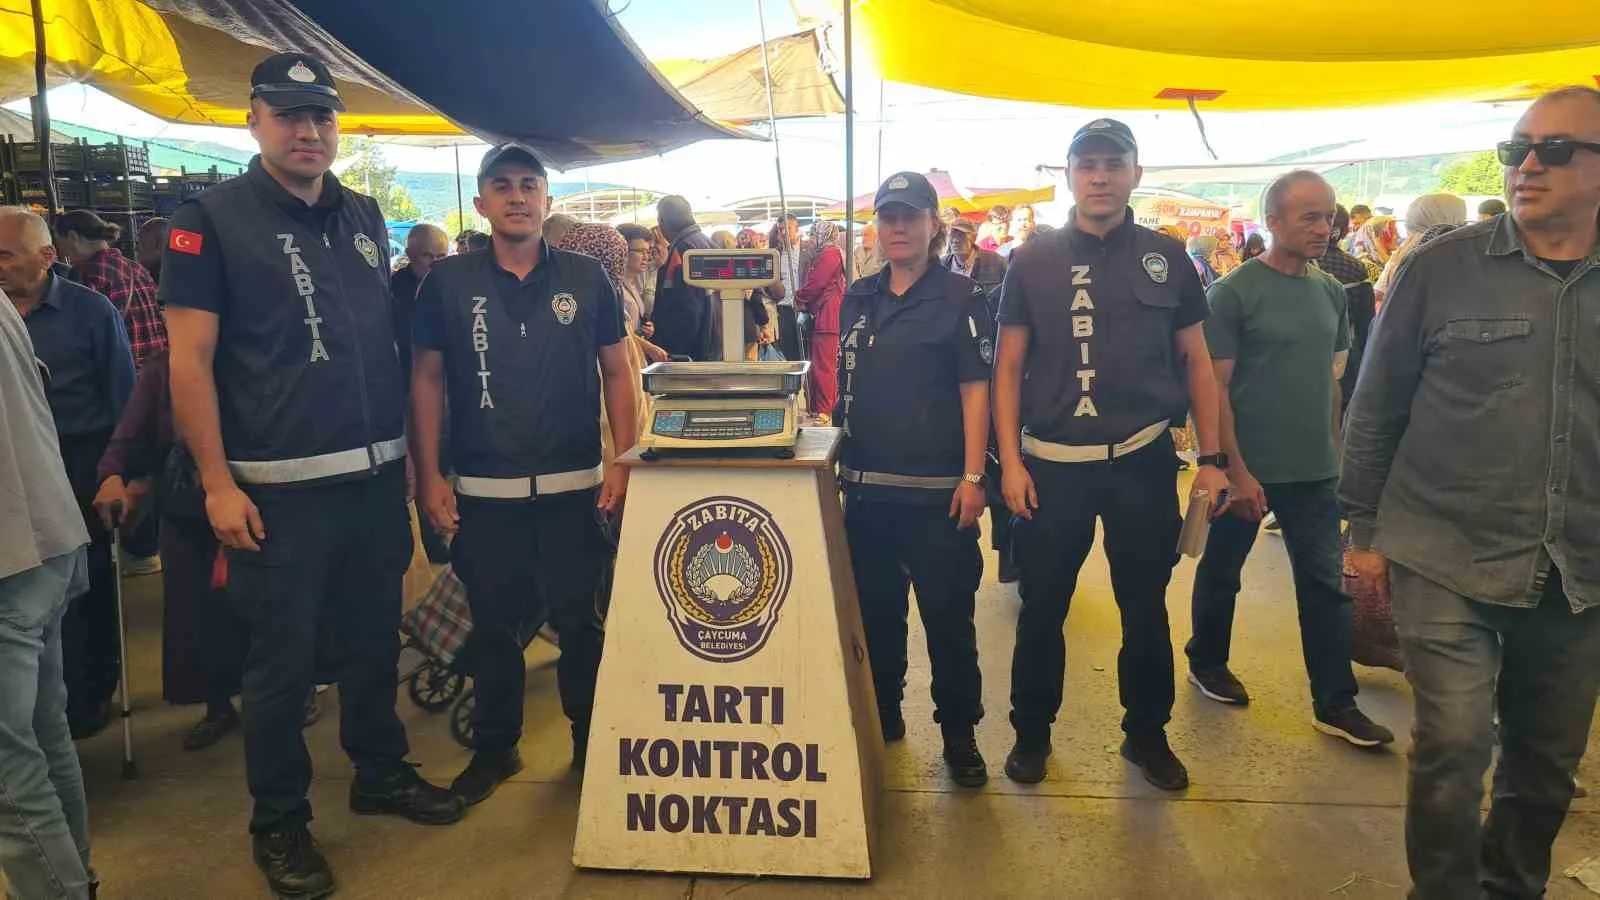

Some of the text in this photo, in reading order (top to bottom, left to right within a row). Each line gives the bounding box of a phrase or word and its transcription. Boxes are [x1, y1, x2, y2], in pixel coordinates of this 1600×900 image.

[276, 233, 330, 362] ZABITA
[472, 296, 494, 408] ZABITA
[1070, 264, 1098, 417] ZABITA
[687, 505, 760, 532] ZABITA
[697, 630, 747, 642] ÇAYCUMA
[657, 684, 784, 725] TARTI
[619, 738, 827, 782] KONTROL
[627, 793, 817, 838] NOKTASI
